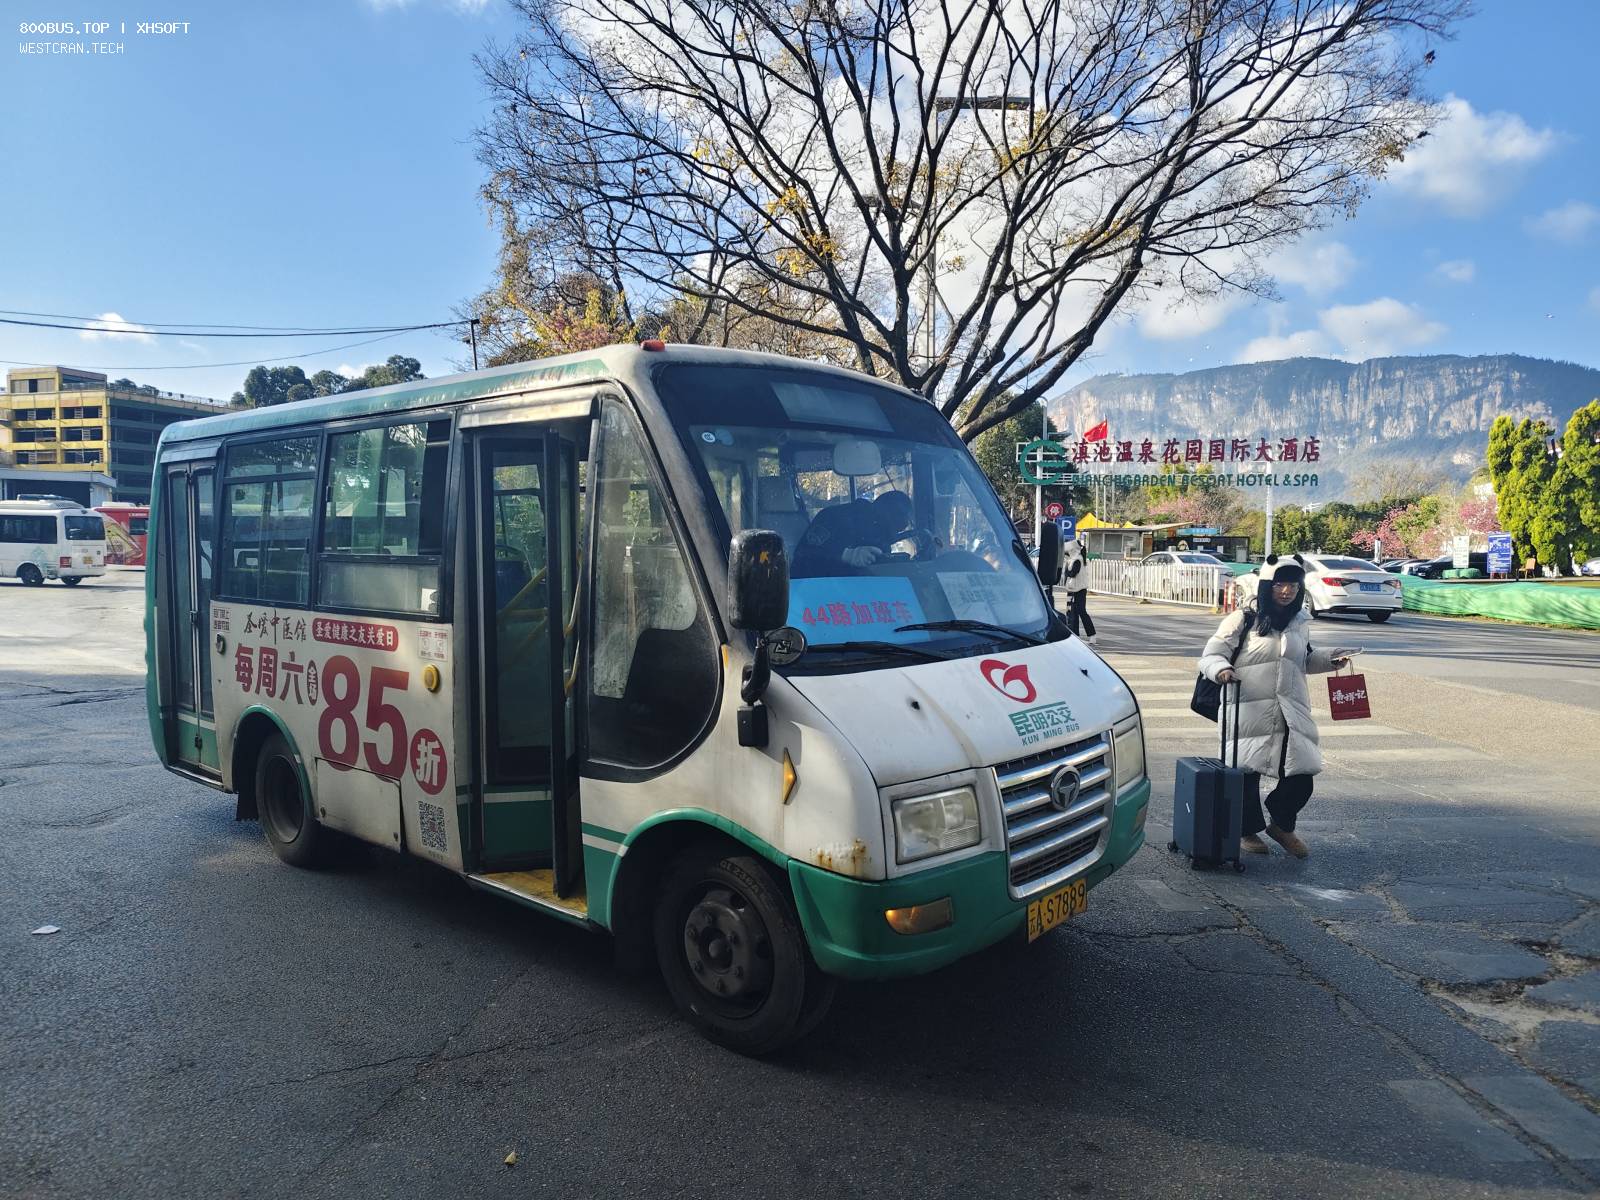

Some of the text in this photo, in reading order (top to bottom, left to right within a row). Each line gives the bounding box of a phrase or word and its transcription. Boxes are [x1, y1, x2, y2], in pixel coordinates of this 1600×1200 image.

[1072, 436, 1321, 464] 滇池温泉花园国际大酒店
[1236, 474, 1279, 486] HOTEL
[1293, 474, 1319, 486] SPA
[1061, 519, 1073, 532] P
[315, 621, 394, 647] 圣爱健康之友关爱日
[235, 643, 304, 705] 每周六
[318, 655, 410, 784] 85
[415, 737, 441, 786] 折
[1008, 701, 1076, 737] 昆明公交
[1022, 723, 1080, 746] KUN MING BUS
